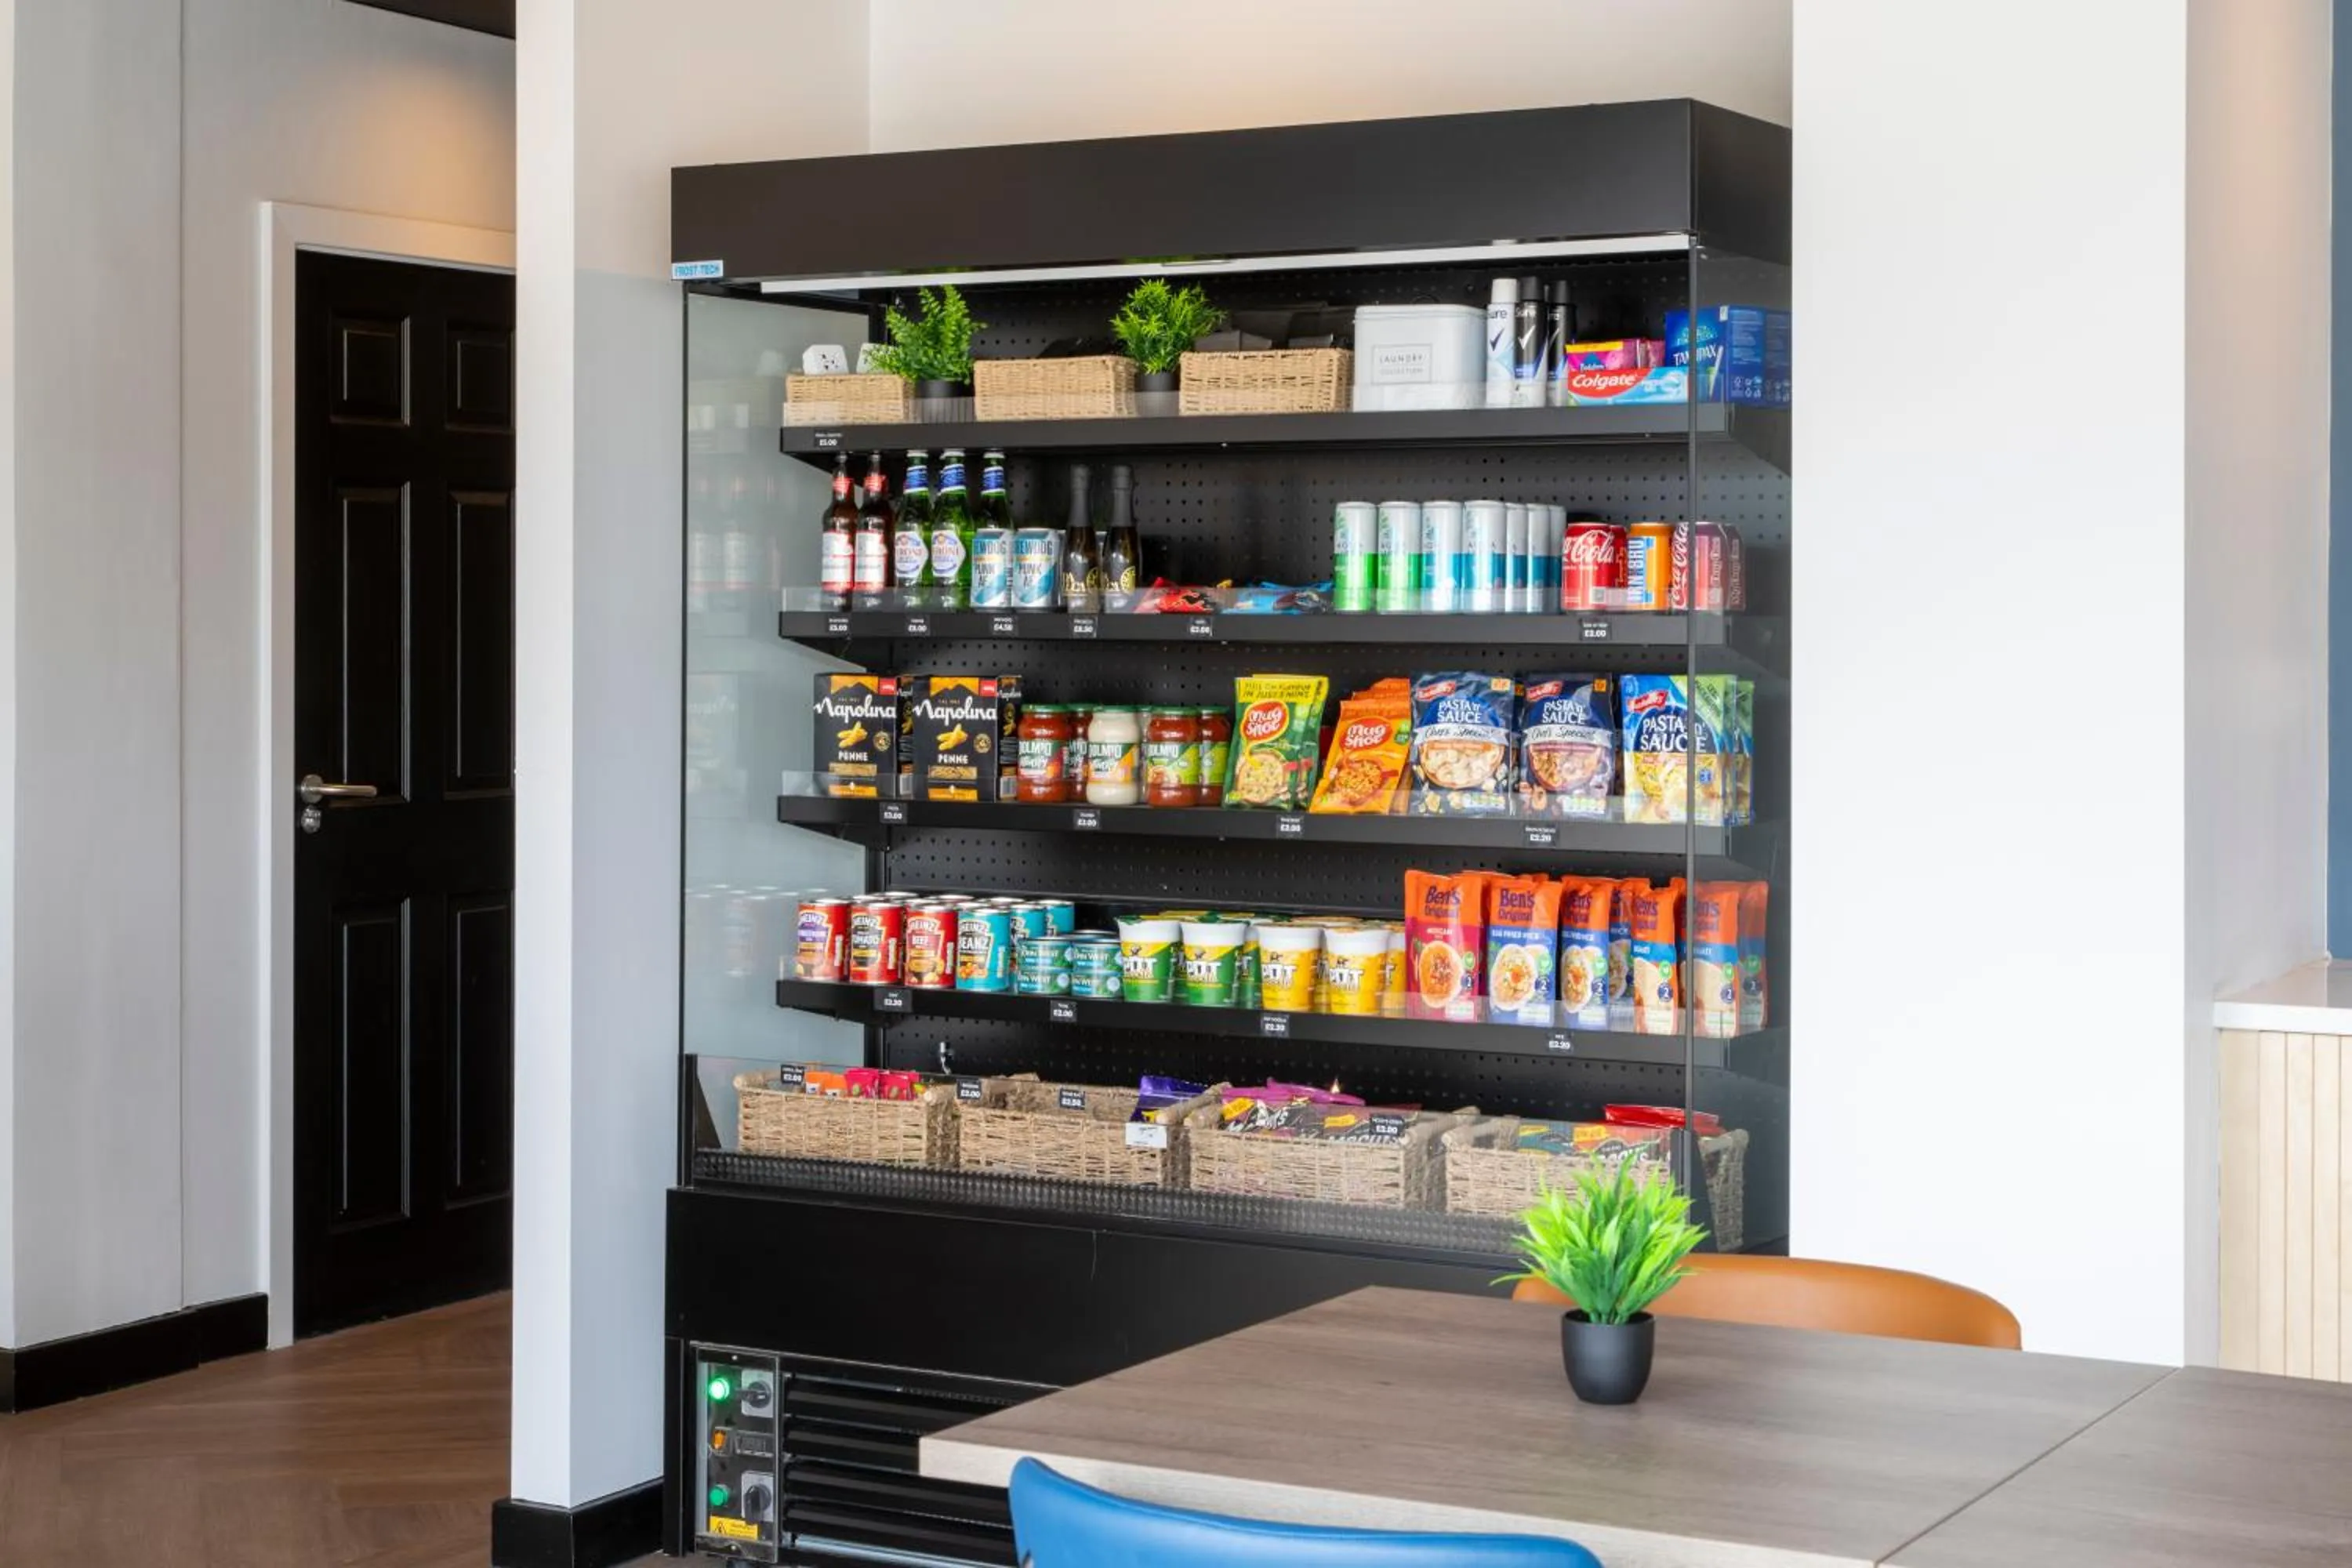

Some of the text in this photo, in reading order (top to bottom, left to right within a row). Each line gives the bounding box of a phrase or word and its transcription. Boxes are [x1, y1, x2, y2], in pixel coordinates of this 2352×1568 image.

[1572, 372, 1636, 390] Colgate
[813, 694, 896, 724] Napolina
[913, 695, 996, 726] Napolina
[1437, 711, 1483, 723] SAUCE
[1541, 711, 1586, 725] SAUCE
[1642, 713, 1684, 735] PASTA
[1640, 732, 1707, 753] SAUCE
[837, 750, 869, 762] PENNE
[937, 753, 969, 765] PENNE
[1425, 884, 1461, 905] Ben's
[1499, 887, 1536, 908] Ben's
